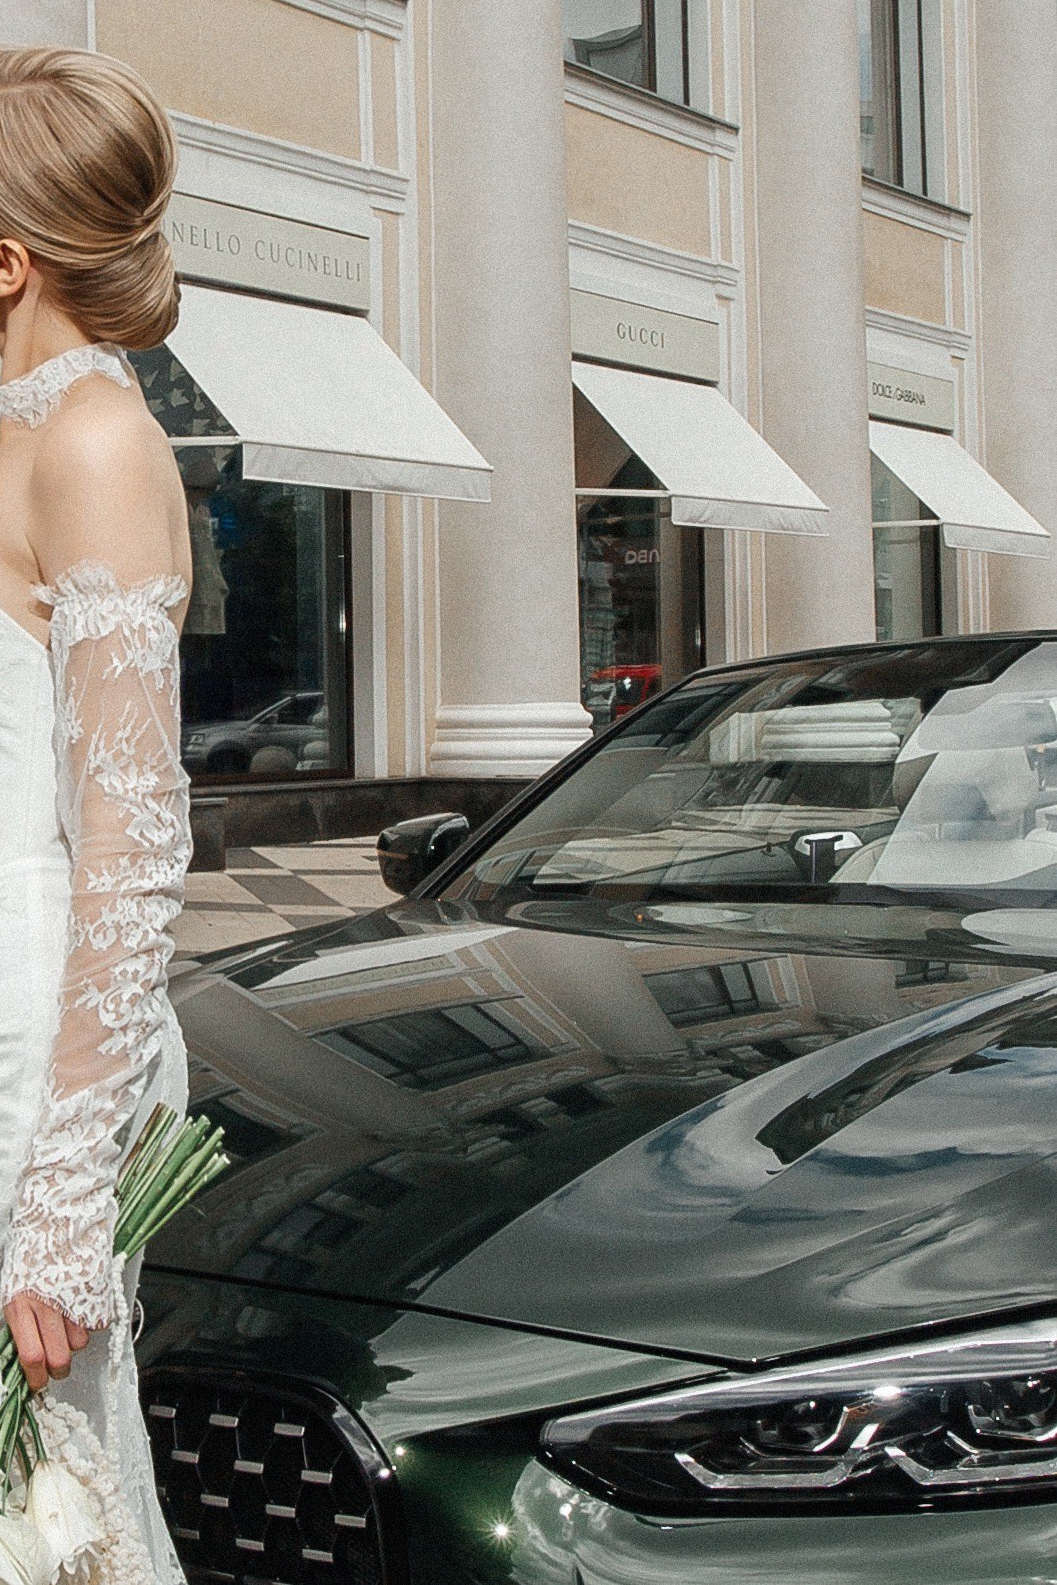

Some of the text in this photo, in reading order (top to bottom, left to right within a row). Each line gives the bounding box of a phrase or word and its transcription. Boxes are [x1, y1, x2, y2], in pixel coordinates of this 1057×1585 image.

[162, 219, 361, 282] NELLO CUCINELLI
[616, 322, 665, 349] GUCCI
